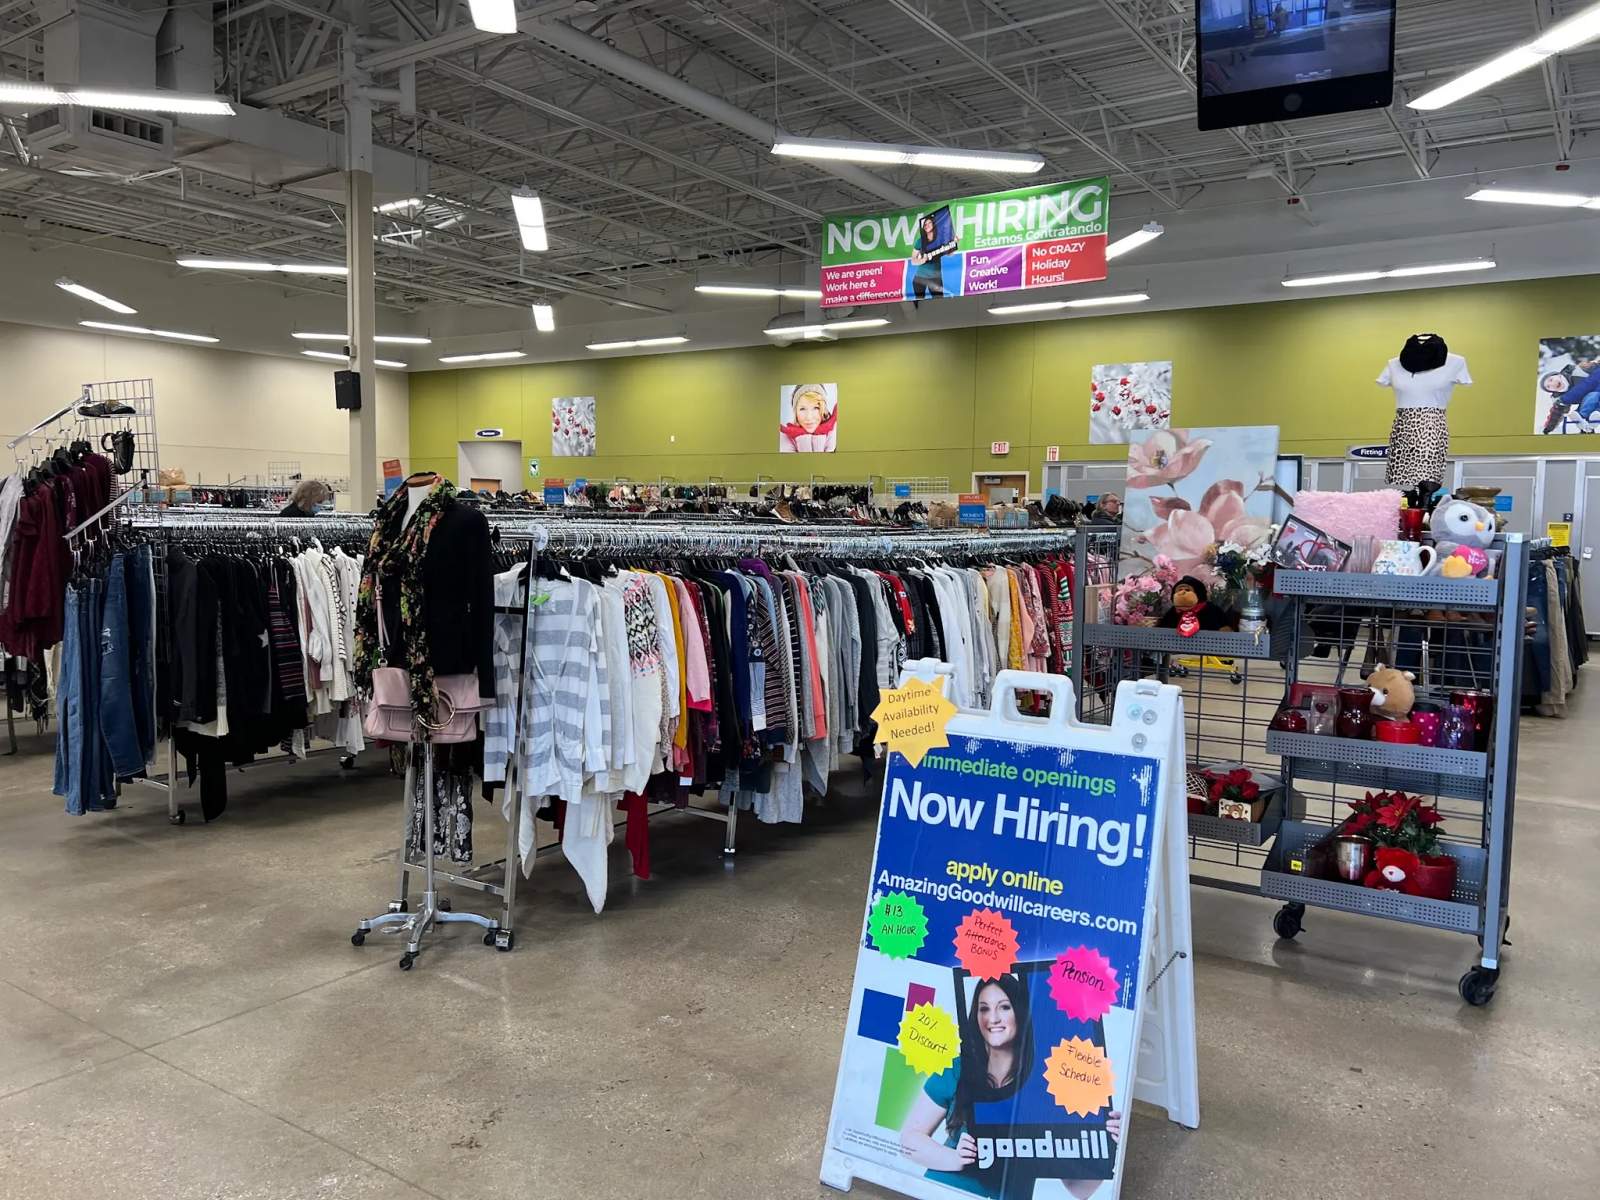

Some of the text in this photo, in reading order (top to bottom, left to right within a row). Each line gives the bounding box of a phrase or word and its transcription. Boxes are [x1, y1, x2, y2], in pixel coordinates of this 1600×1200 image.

[828, 185, 1102, 254] NOW HIRING
[974, 222, 1102, 249] Estamos Contratando
[1032, 242, 1085, 257] No CRAZY
[970, 256, 991, 265] Fun,
[1032, 258, 1071, 271] Holiday
[826, 272, 840, 280] We
[855, 267, 882, 279] green!
[969, 265, 1009, 278] Creative
[1031, 272, 1064, 284] Hours!
[826, 279, 876, 292] Work here &
[969, 280, 998, 291] Work!
[825, 293, 848, 304] make
[856, 289, 902, 301] difference!
[1360, 448, 1383, 456] Fitting
[888, 688, 931, 703] Daytime
[883, 705, 939, 722] Availability
[891, 721, 935, 739] Needed!
[1022, 767, 1117, 795] openings
[888, 778, 1148, 867] Now Hiring!
[946, 859, 1064, 896] apply online
[877, 869, 1137, 935] AmazingGoodwillcareers.com
[881, 924, 917, 935] AN HOUR
[975, 915, 1003, 936] Perfect
[970, 943, 998, 960] BONUS
[1060, 960, 1105, 991] Pension
[909, 1027, 948, 1054] Discount
[1066, 1044, 1102, 1067] Flexible
[1059, 1062, 1102, 1085] Schedule
[977, 1130, 1109, 1169] goodwill
